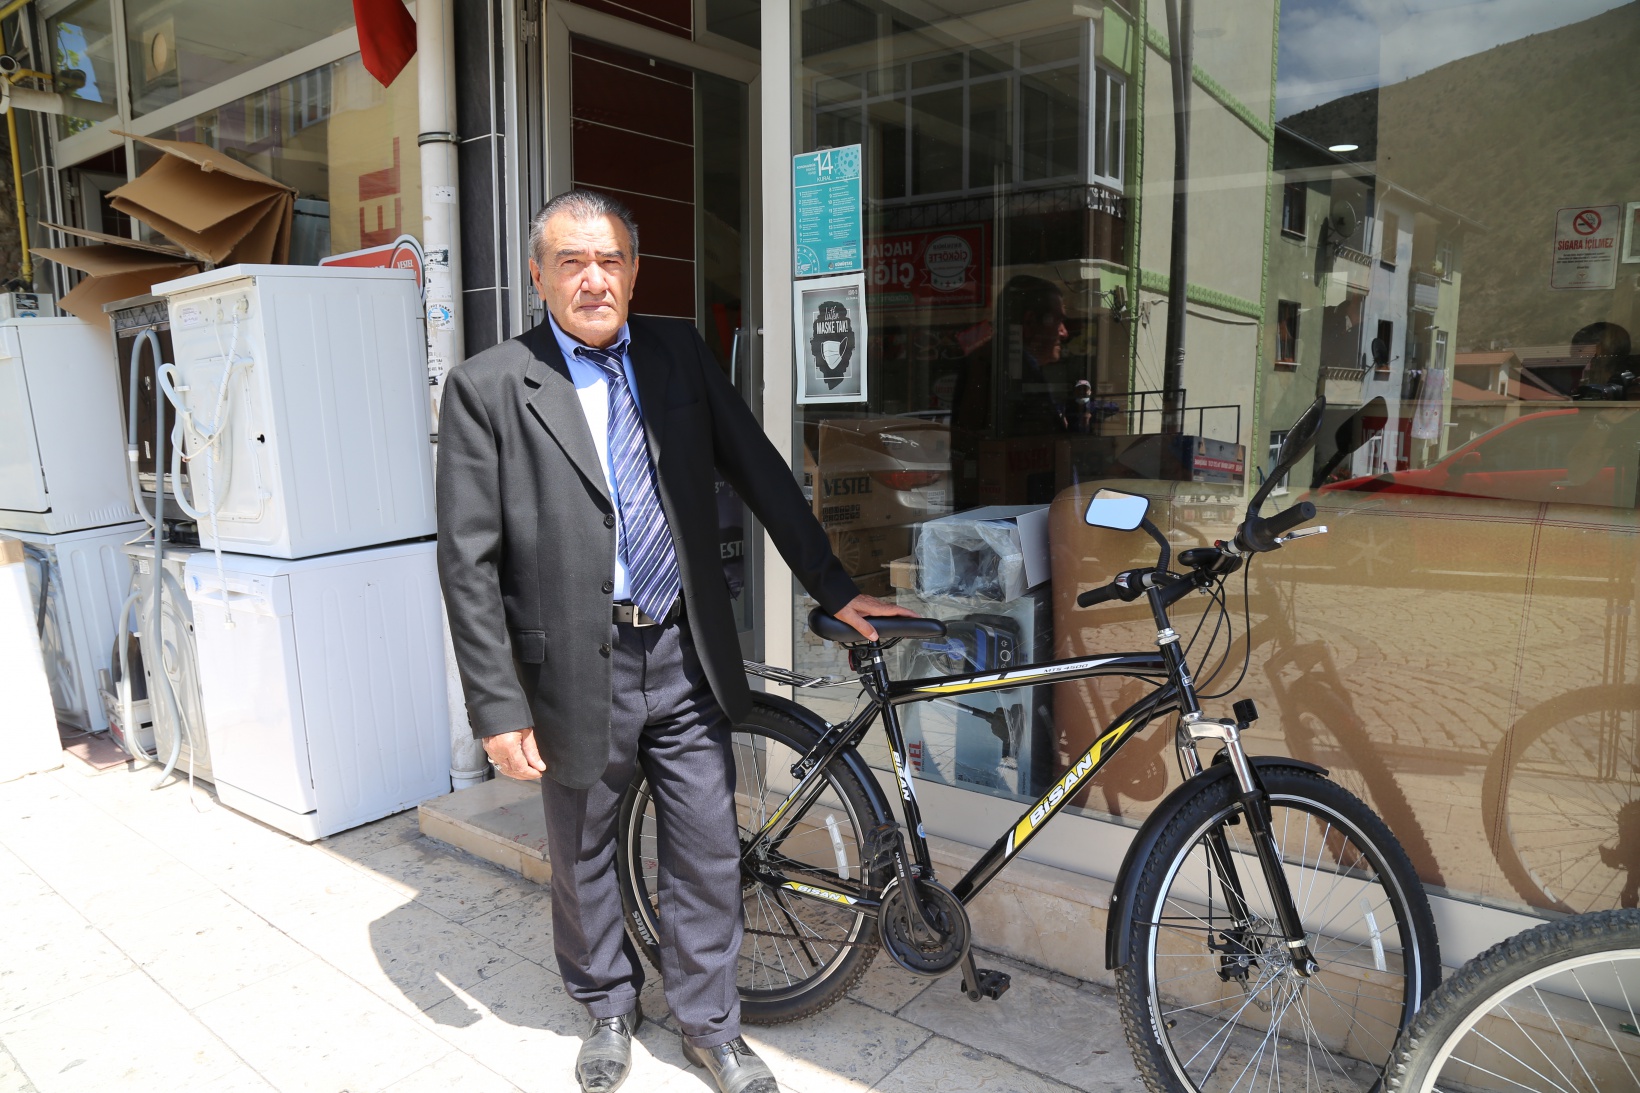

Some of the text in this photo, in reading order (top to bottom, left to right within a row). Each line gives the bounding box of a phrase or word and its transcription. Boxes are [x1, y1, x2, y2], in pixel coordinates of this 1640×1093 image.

[813, 151, 834, 177] 14
[816, 320, 849, 335] MASKE TAK!
[823, 476, 873, 497] VESTEL
